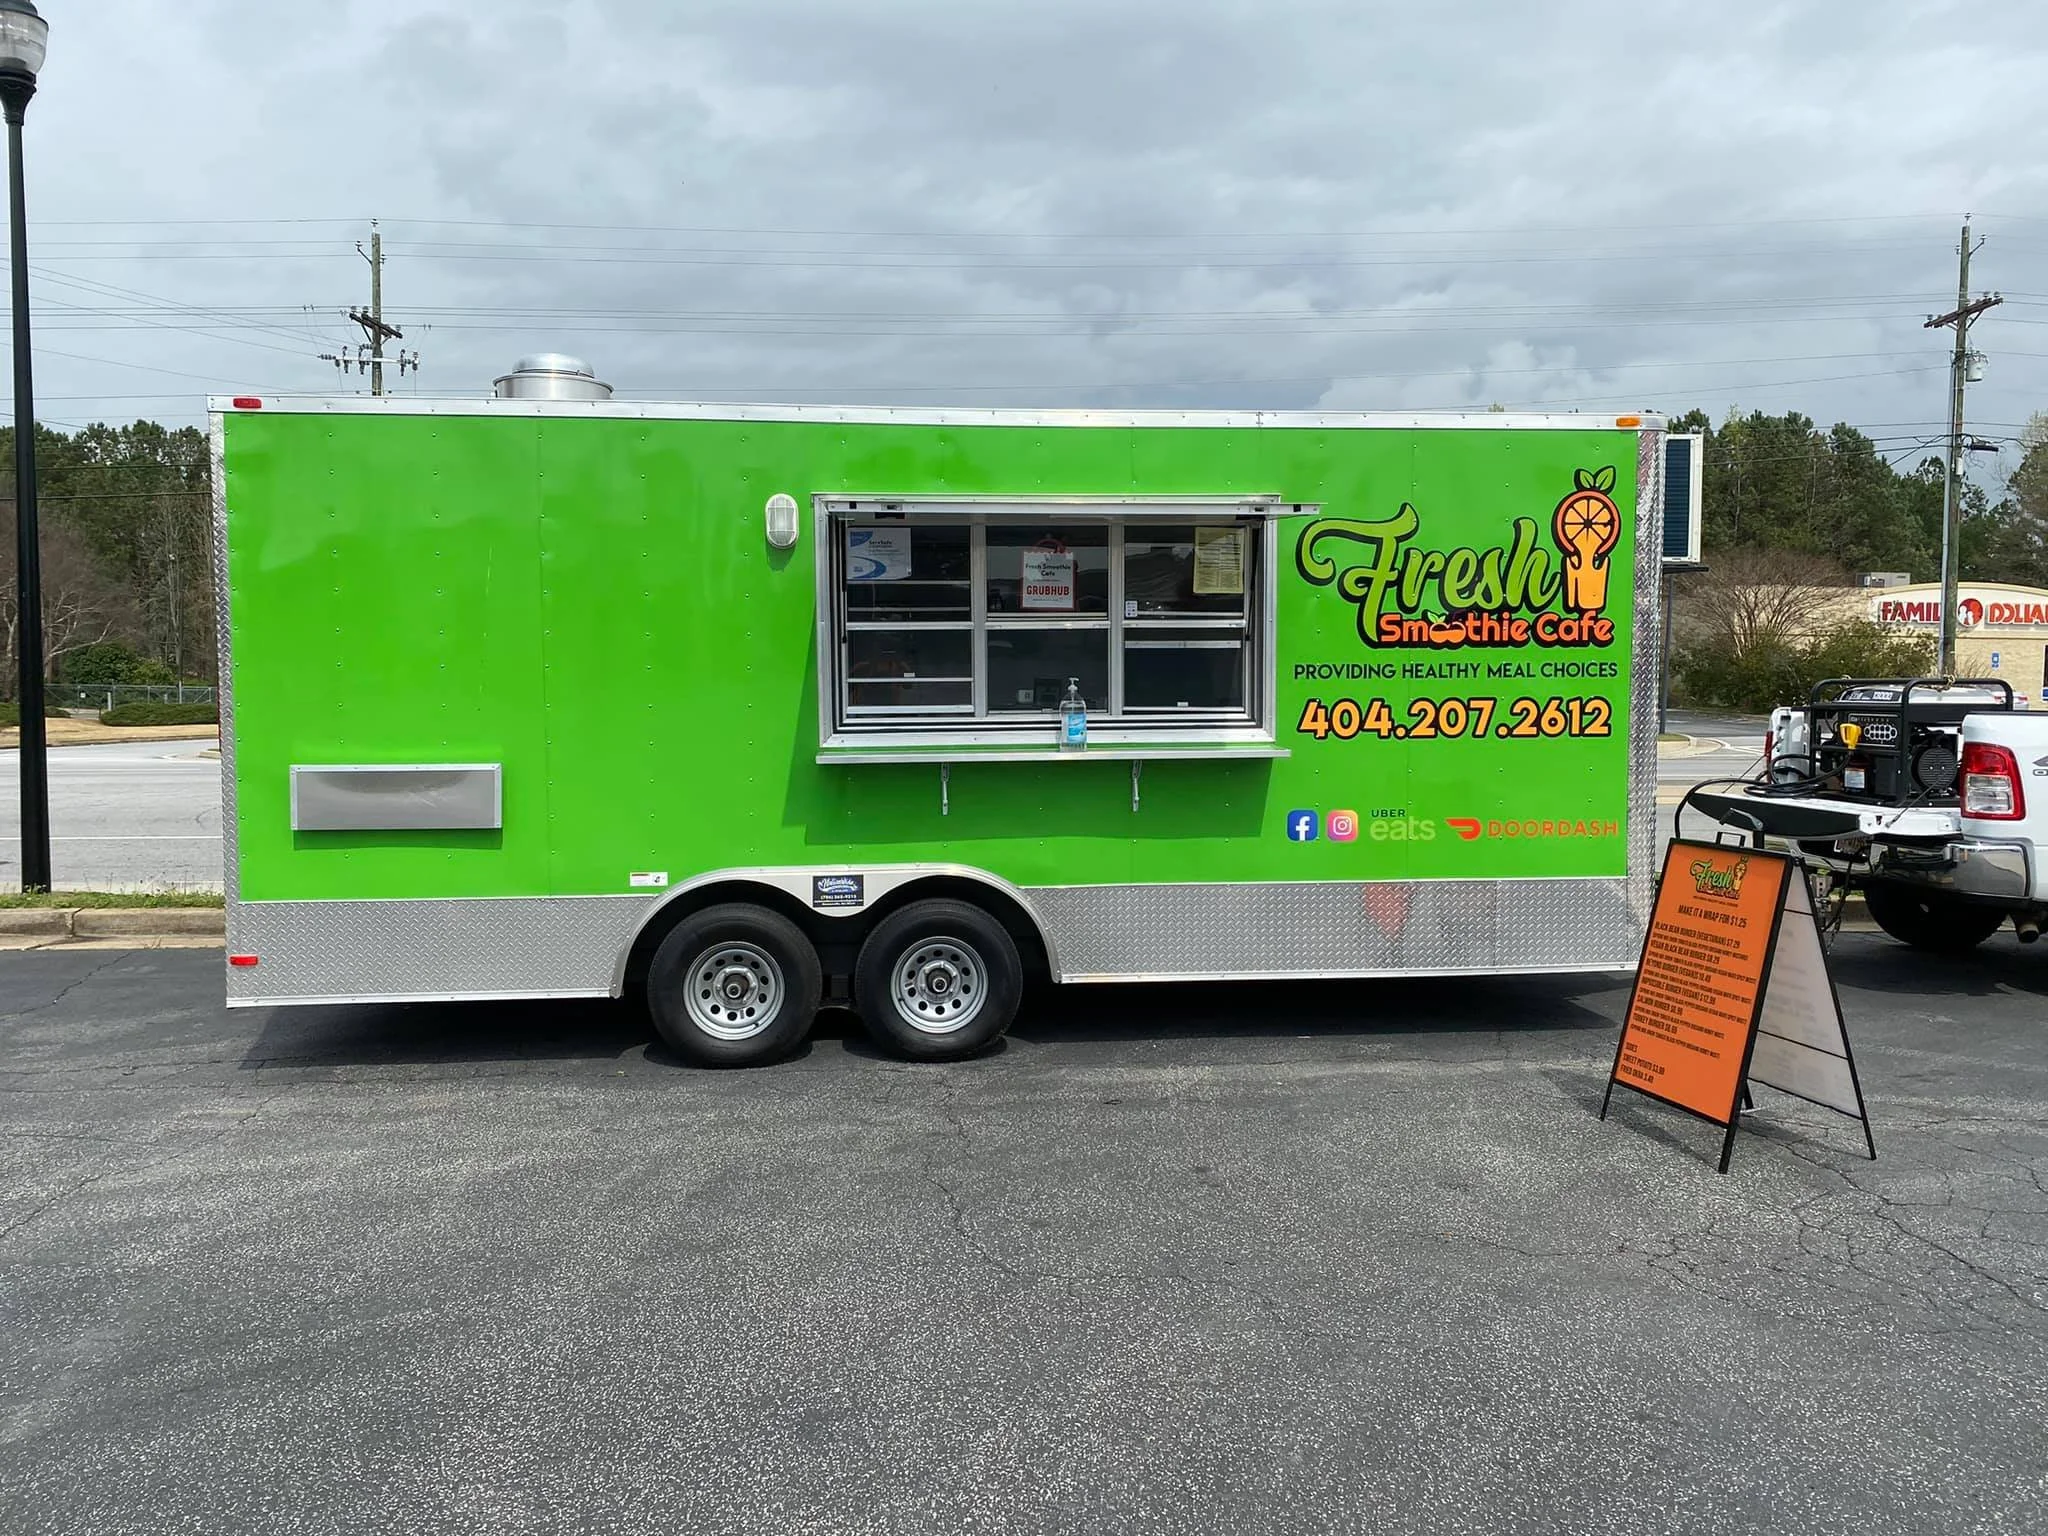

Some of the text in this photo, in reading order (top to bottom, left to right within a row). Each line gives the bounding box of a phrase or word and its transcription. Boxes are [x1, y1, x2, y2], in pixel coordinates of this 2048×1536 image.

[1296, 502, 1563, 647] Fresh
[1026, 585, 1070, 596] GRUBHUB
[1881, 601, 1941, 623] FAMIL
[1379, 609, 1615, 646] Smoothie Cafe
[1294, 661, 1618, 680] PROVIDING HEALTHY MEAL CHOICES
[1297, 696, 1613, 740] 404.207.2612
[1371, 809, 1406, 818] UBER
[1369, 817, 1436, 842] eats
[1487, 818, 1618, 838] DOORDASH
[1655, 921, 1668, 931] BLACK
[1678, 904, 1693, 915] MAKE
[1703, 909, 1719, 921] WRAP
[1719, 913, 1730, 924] FOR
[1731, 915, 1747, 928] $1.25
[1664, 943, 1677, 953] BLACK
